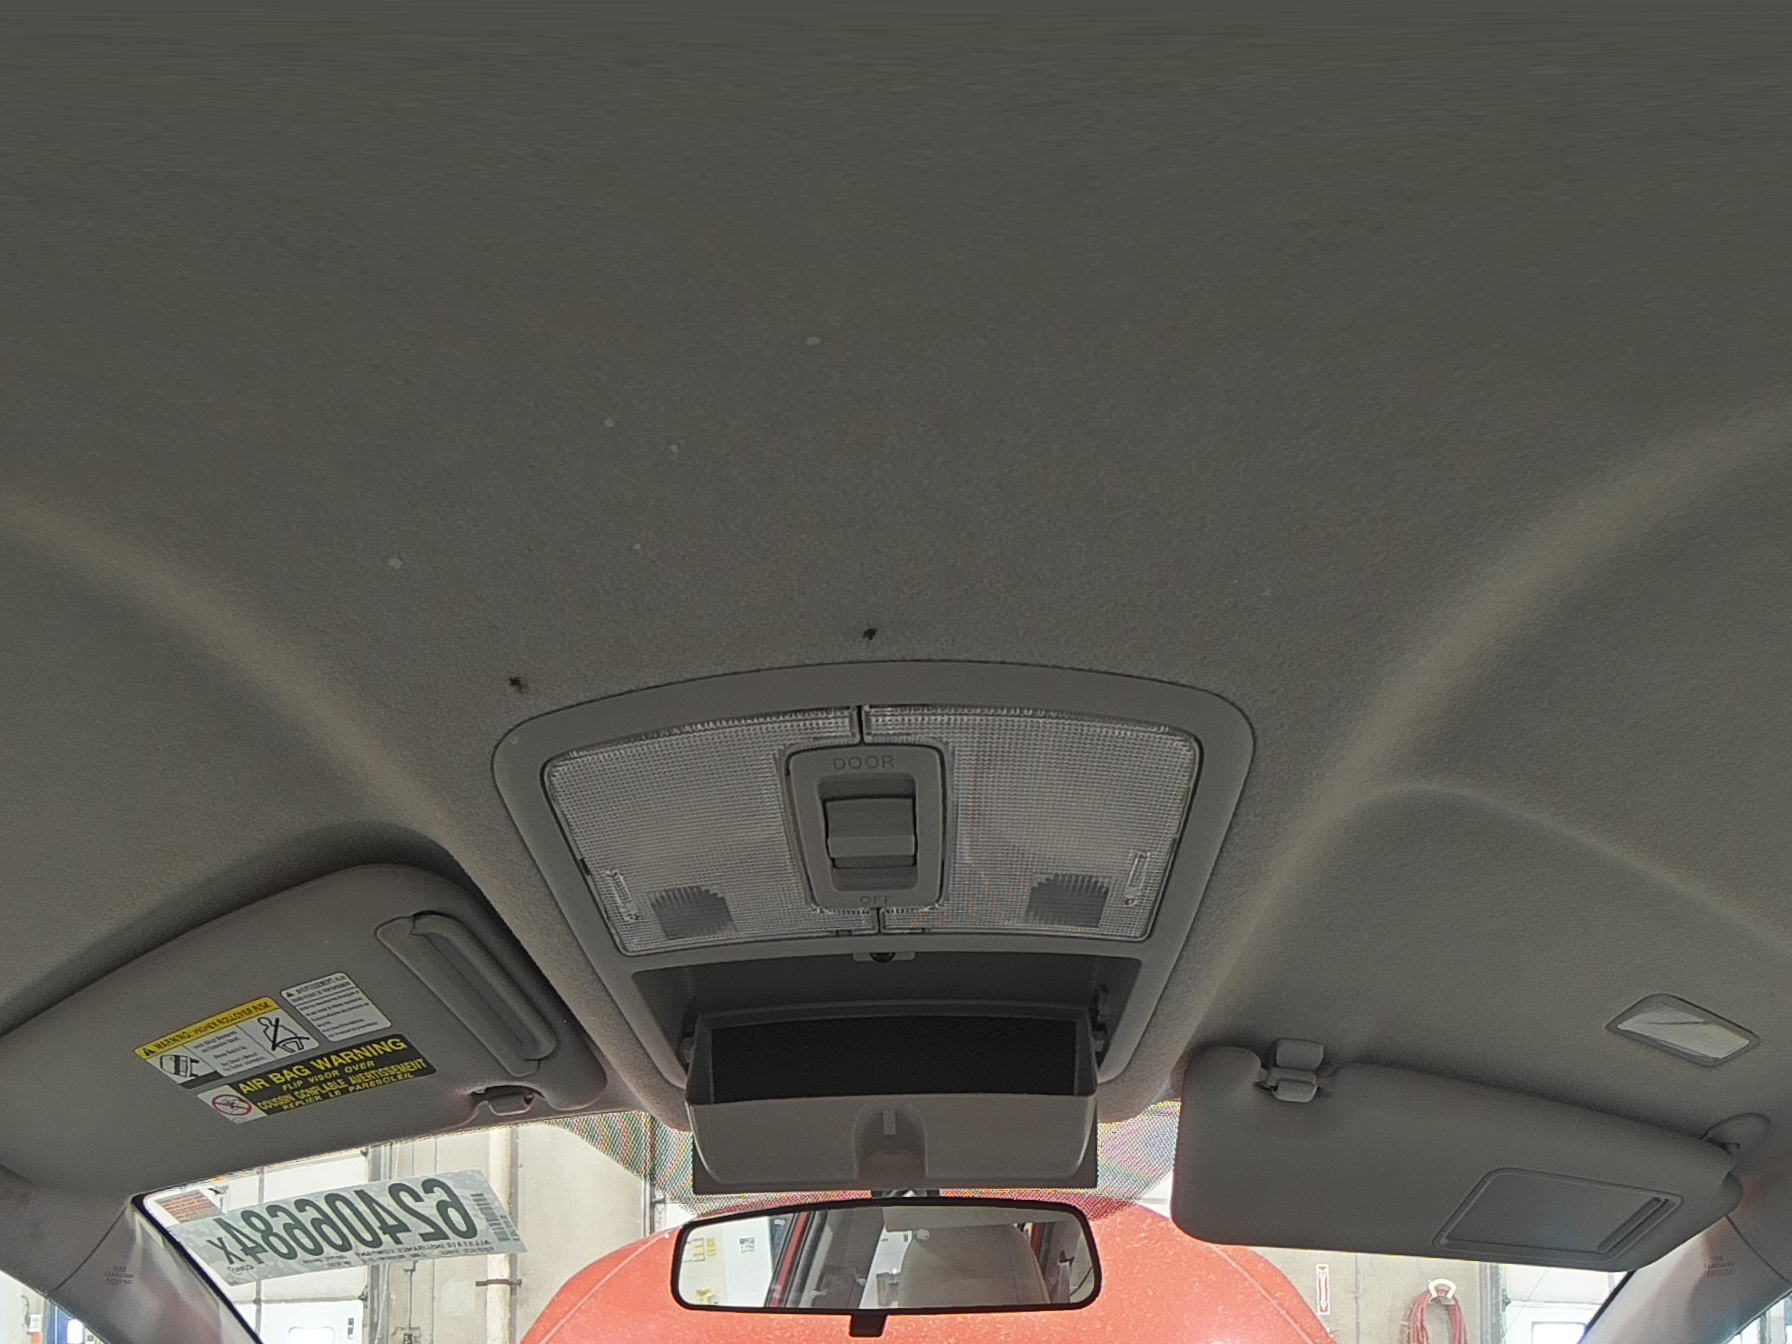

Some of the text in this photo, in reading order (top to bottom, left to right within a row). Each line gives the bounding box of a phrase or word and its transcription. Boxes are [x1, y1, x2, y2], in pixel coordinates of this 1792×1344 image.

[832, 755, 895, 771] DOOR
[859, 895, 893, 905] OFF
[238, 1038, 408, 1094] AIR BAG WARNING
[282, 1060, 376, 1092] FLIP VISOR OVER
[348, 1058, 427, 1086] AVERTISSEMENT
